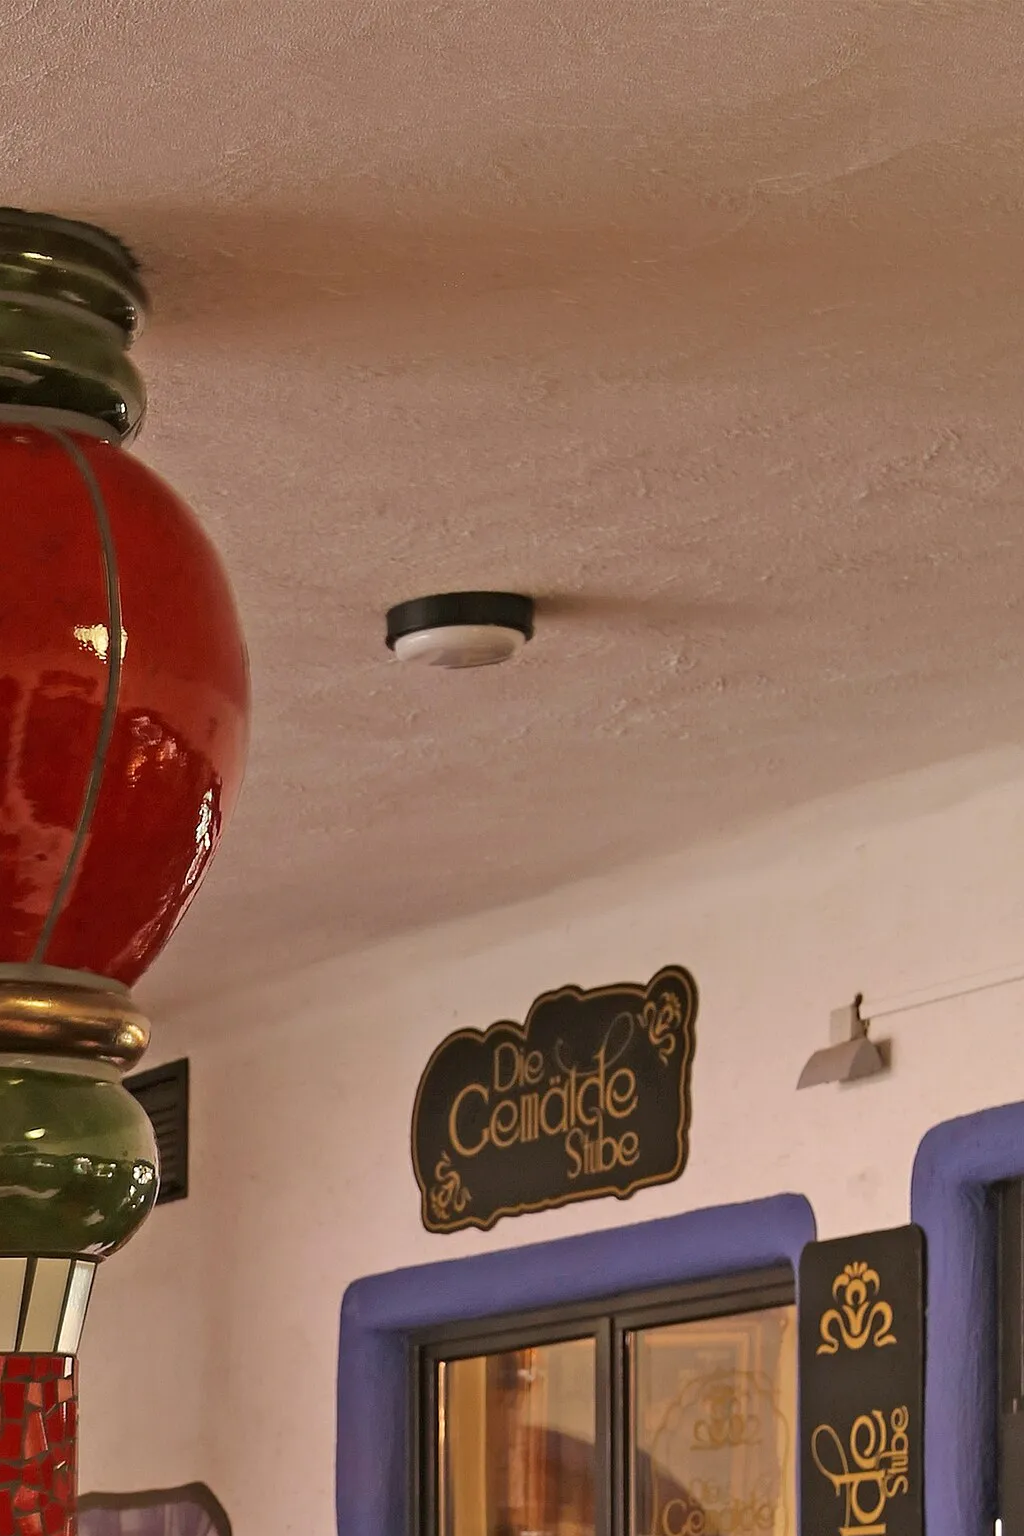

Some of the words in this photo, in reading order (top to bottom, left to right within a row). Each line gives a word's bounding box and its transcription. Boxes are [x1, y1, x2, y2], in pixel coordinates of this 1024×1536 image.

[494, 1042, 544, 1092] Die
[565, 1106, 640, 1179] Stube
[879, 1405, 910, 1499] Stube
